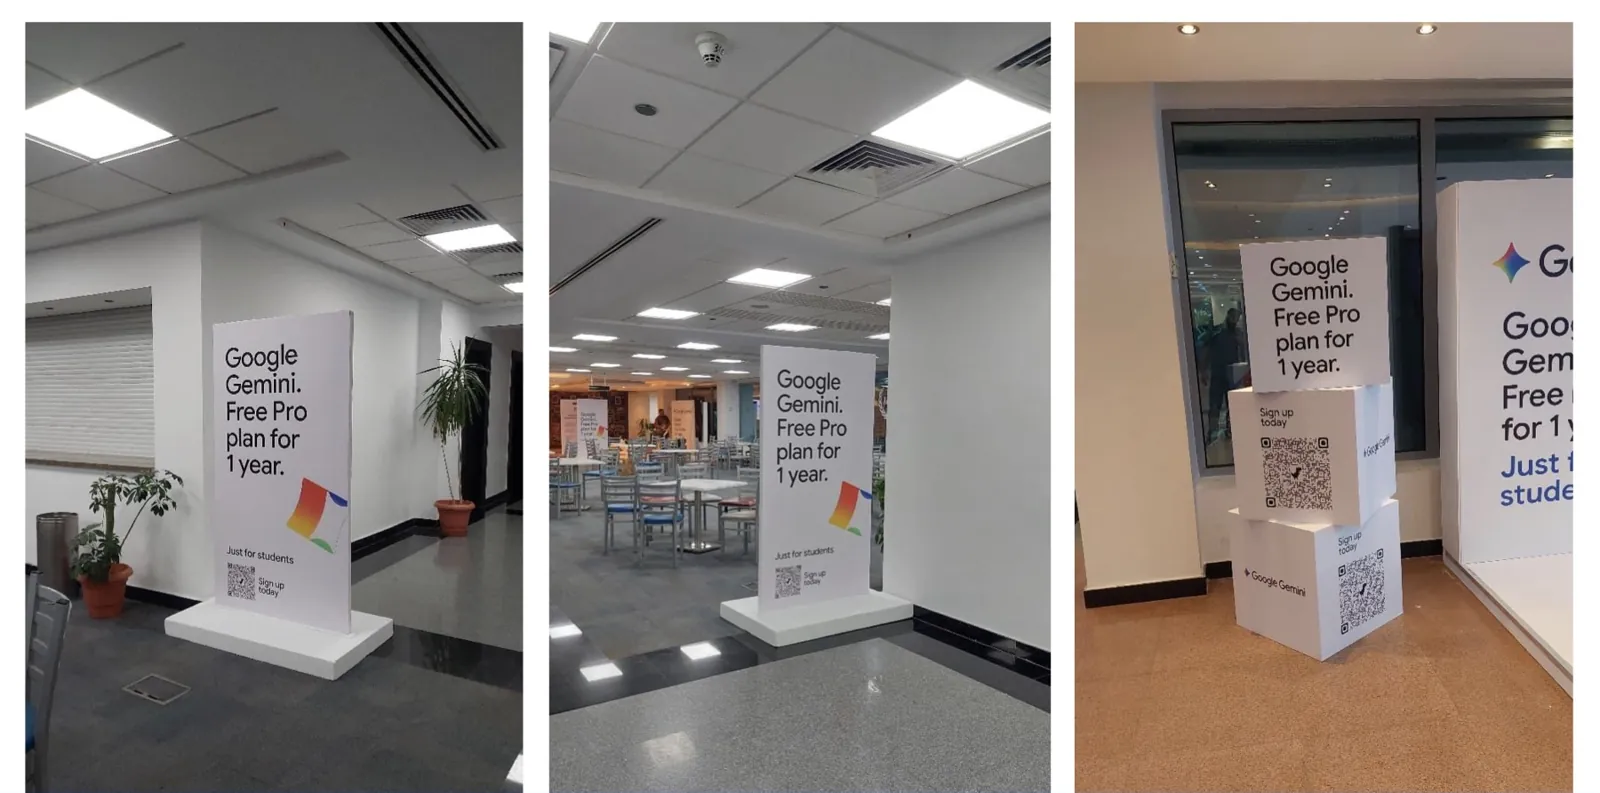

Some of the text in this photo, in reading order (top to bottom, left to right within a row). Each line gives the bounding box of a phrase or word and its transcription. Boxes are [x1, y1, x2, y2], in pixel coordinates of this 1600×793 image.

[1270, 255, 1348, 280] Google
[1272, 279, 1353, 301] Gemini.
[1274, 305, 1360, 327] Free Pro
[1503, 311, 1573, 341] Goo
[1276, 330, 1354, 356] plan for
[225, 344, 298, 372] Google
[1277, 358, 1340, 379] 1 year.
[1502, 348, 1573, 375] Gem
[225, 372, 301, 395] Gemini.
[777, 369, 841, 395] Google
[777, 394, 843, 413] Gemini.
[1503, 384, 1564, 409] Free
[226, 401, 308, 422] Free Pro
[1260, 407, 1294, 419] Sign up
[777, 418, 847, 436] Free Pro
[1261, 418, 1287, 429] today
[1502, 417, 1542, 441] for
[1550, 414, 1560, 437] 1
[226, 428, 300, 452] plan for
[776, 442, 841, 465] plan for
[227, 454, 285, 479] 1 year.
[1501, 454, 1560, 478] Just
[777, 467, 828, 488] 1 year.
[1338, 531, 1361, 547] Sign up
[1338, 543, 1357, 556] today
[226, 545, 295, 565] Just for students
[775, 546, 835, 561] Just for students
[258, 577, 285, 591] Sign up
[803, 571, 817, 580] Sign
[1251, 570, 1306, 597] Google Gemini
[258, 585, 279, 599] today
